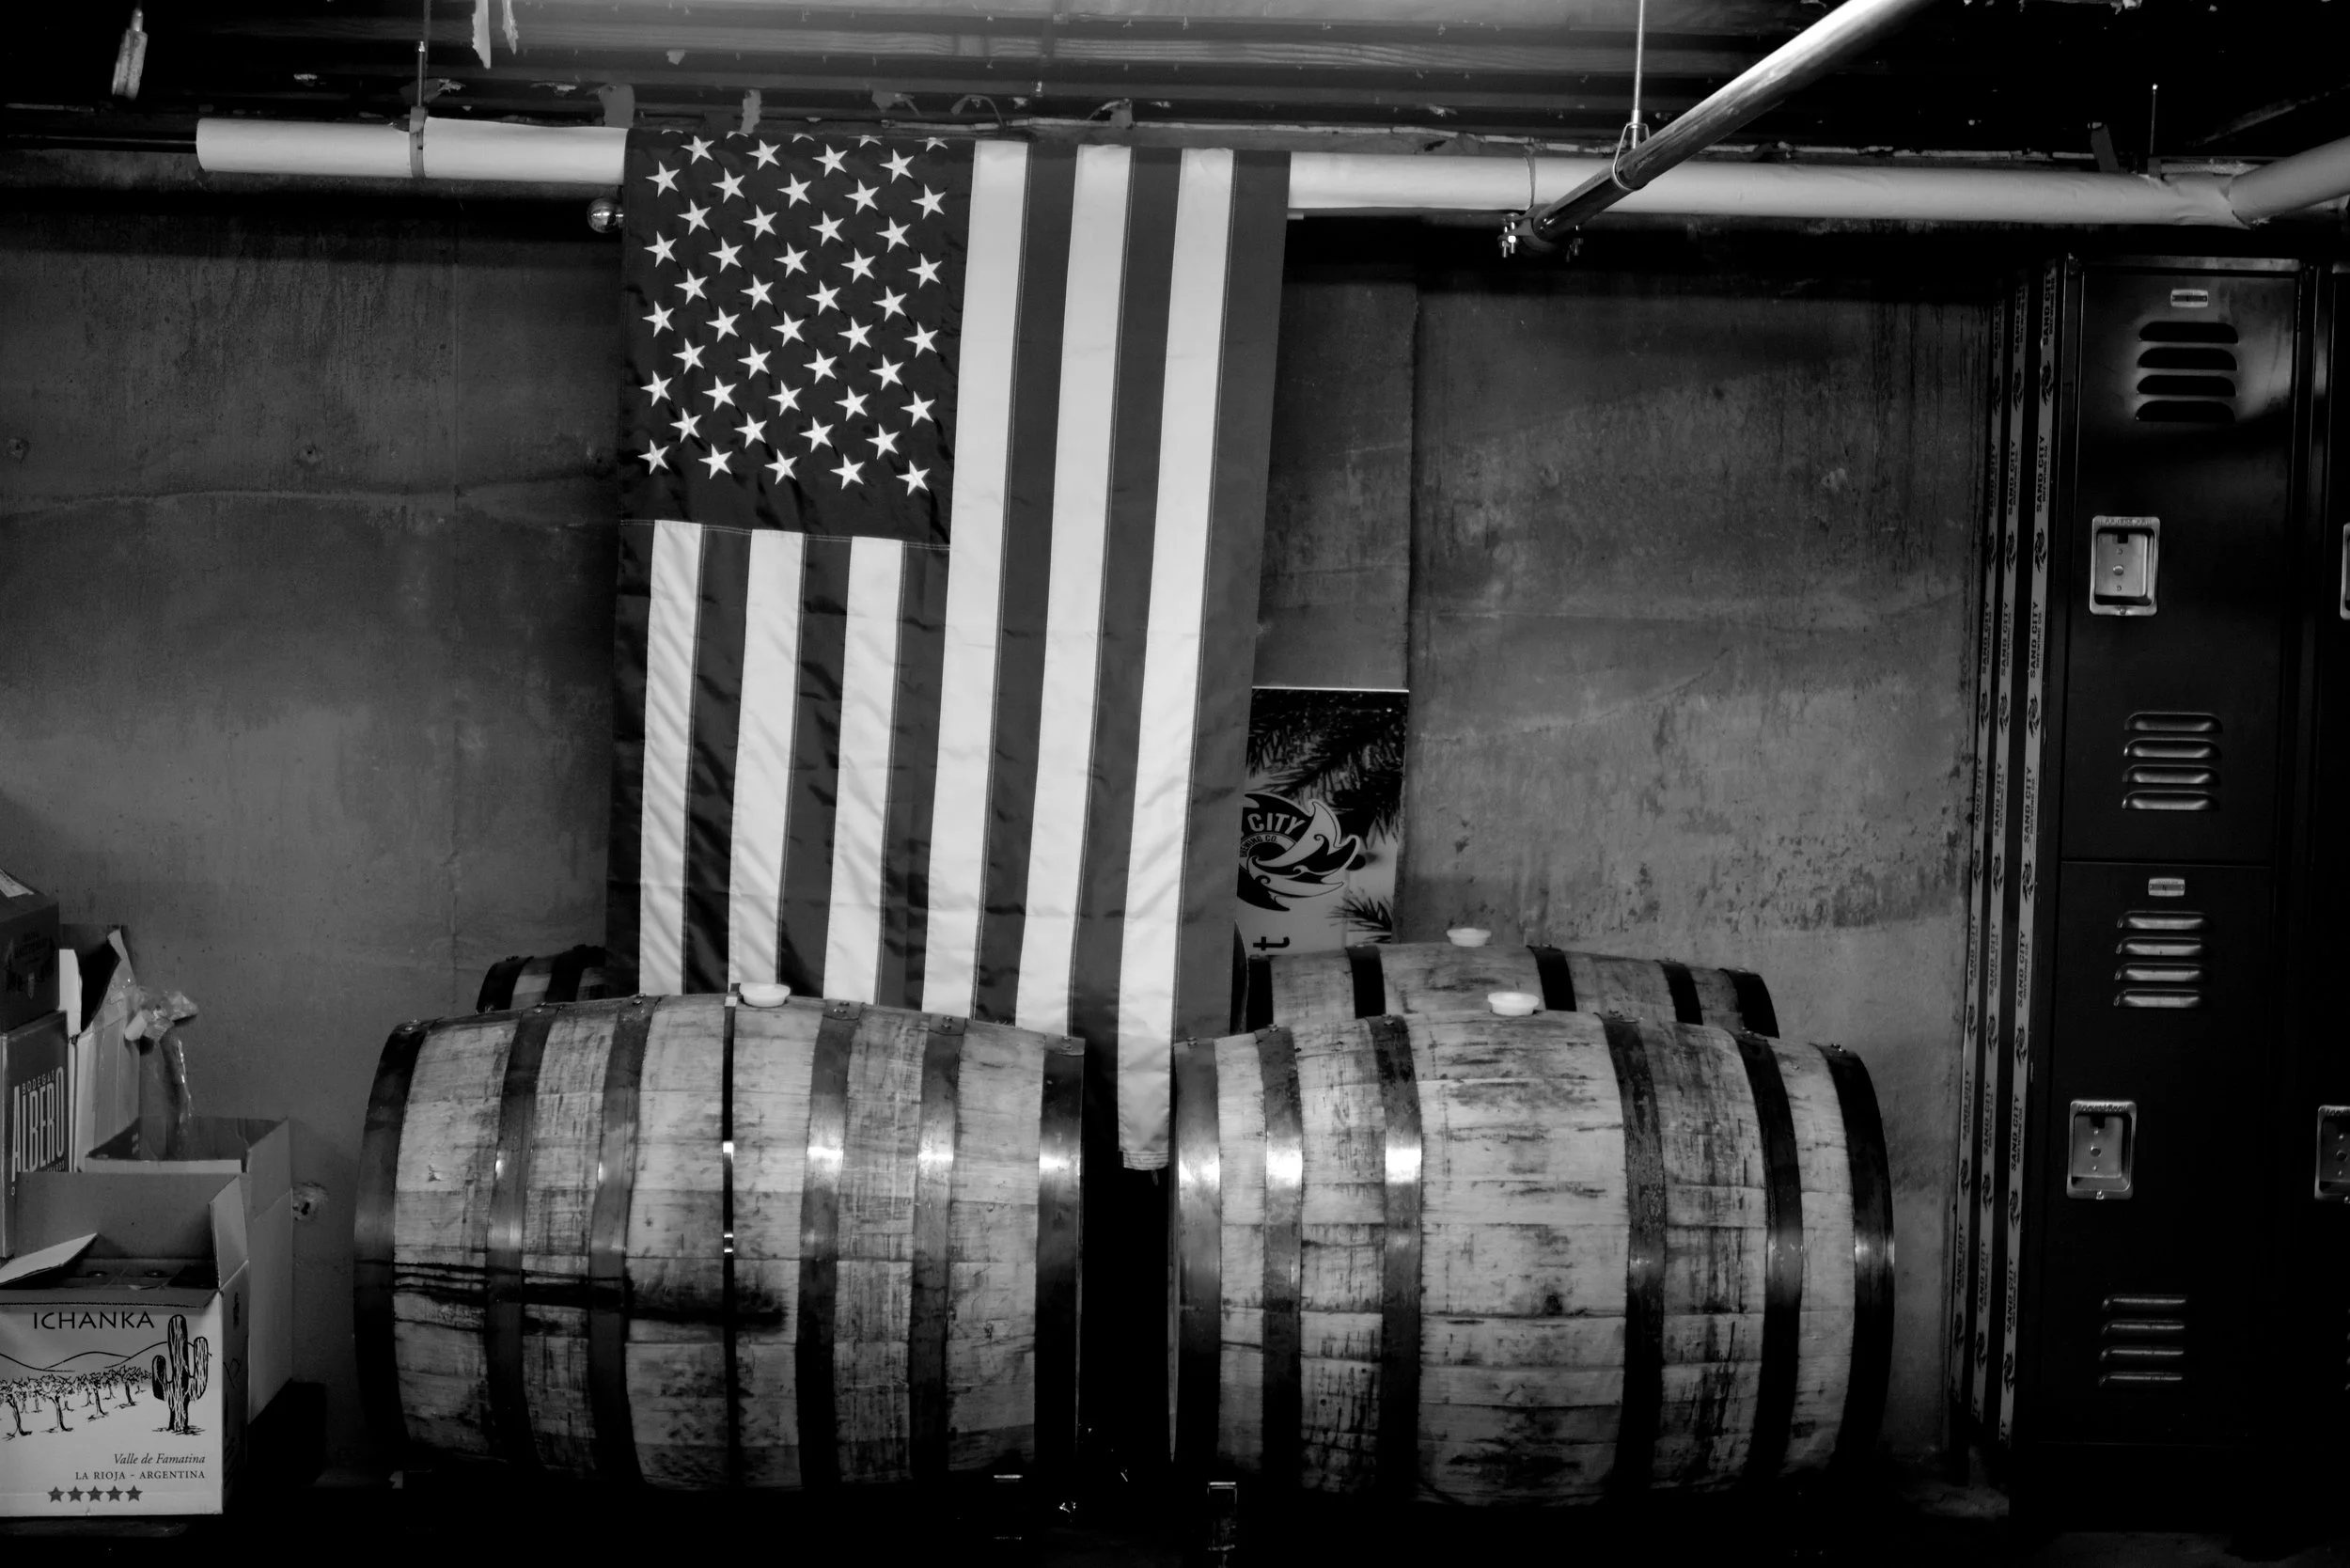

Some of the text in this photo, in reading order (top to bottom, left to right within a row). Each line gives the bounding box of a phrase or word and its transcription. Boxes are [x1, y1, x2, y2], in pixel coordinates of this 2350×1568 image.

[1247, 812, 1306, 835] CITY
[2023, 804, 2031, 843] SAND
[22, 1069, 55, 1094] BODEGAS
[11, 1066, 65, 1183] ALBERO
[34, 1310, 155, 1329] ICHANKA
[114, 1452, 206, 1465] Valle de Famatina
[75, 1471, 88, 1481] LA
[94, 1471, 126, 1482] RIOJA
[139, 1470, 206, 1480] ARGENTINA
